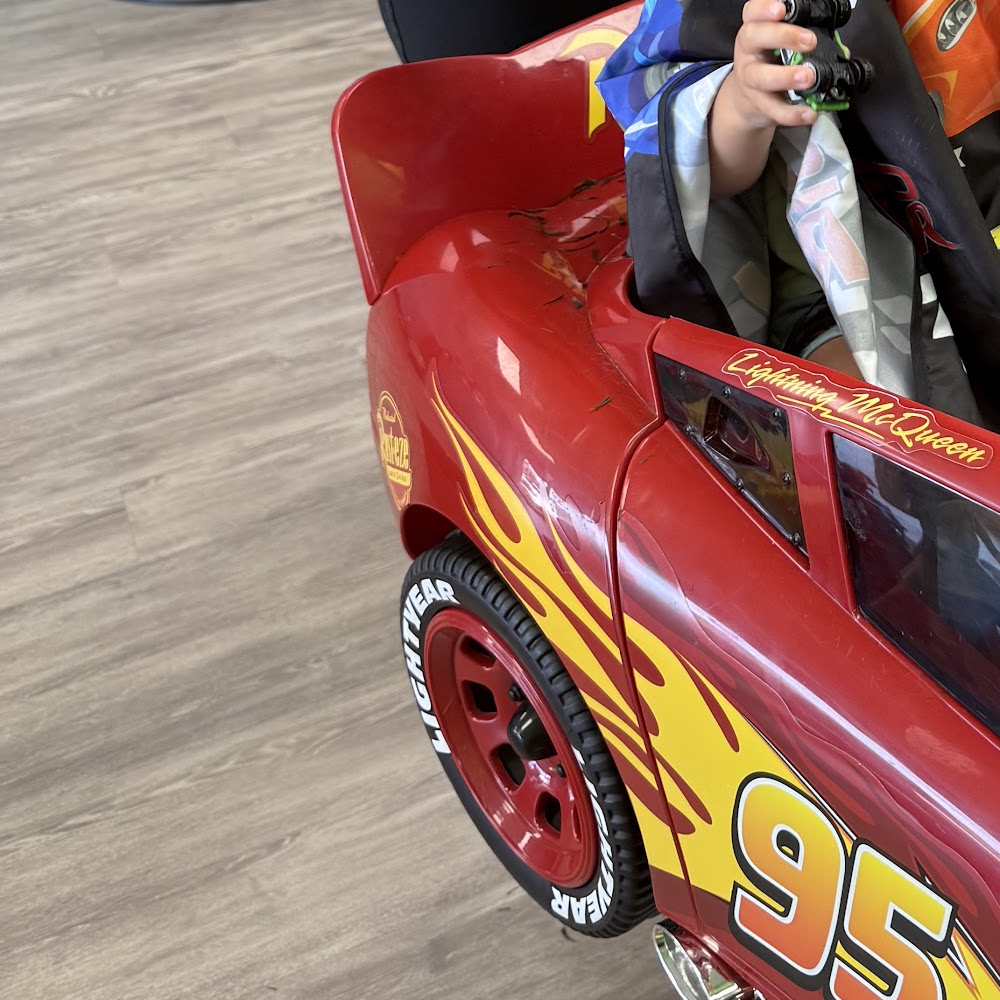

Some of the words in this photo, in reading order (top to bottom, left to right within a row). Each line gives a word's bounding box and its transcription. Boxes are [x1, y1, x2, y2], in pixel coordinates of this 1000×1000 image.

[727, 352, 839, 411] Lightning
[837, 392, 985, 464] McQueen
[403, 577, 461, 754] LIGHTYEAR
[728, 771, 958, 1000] 95
